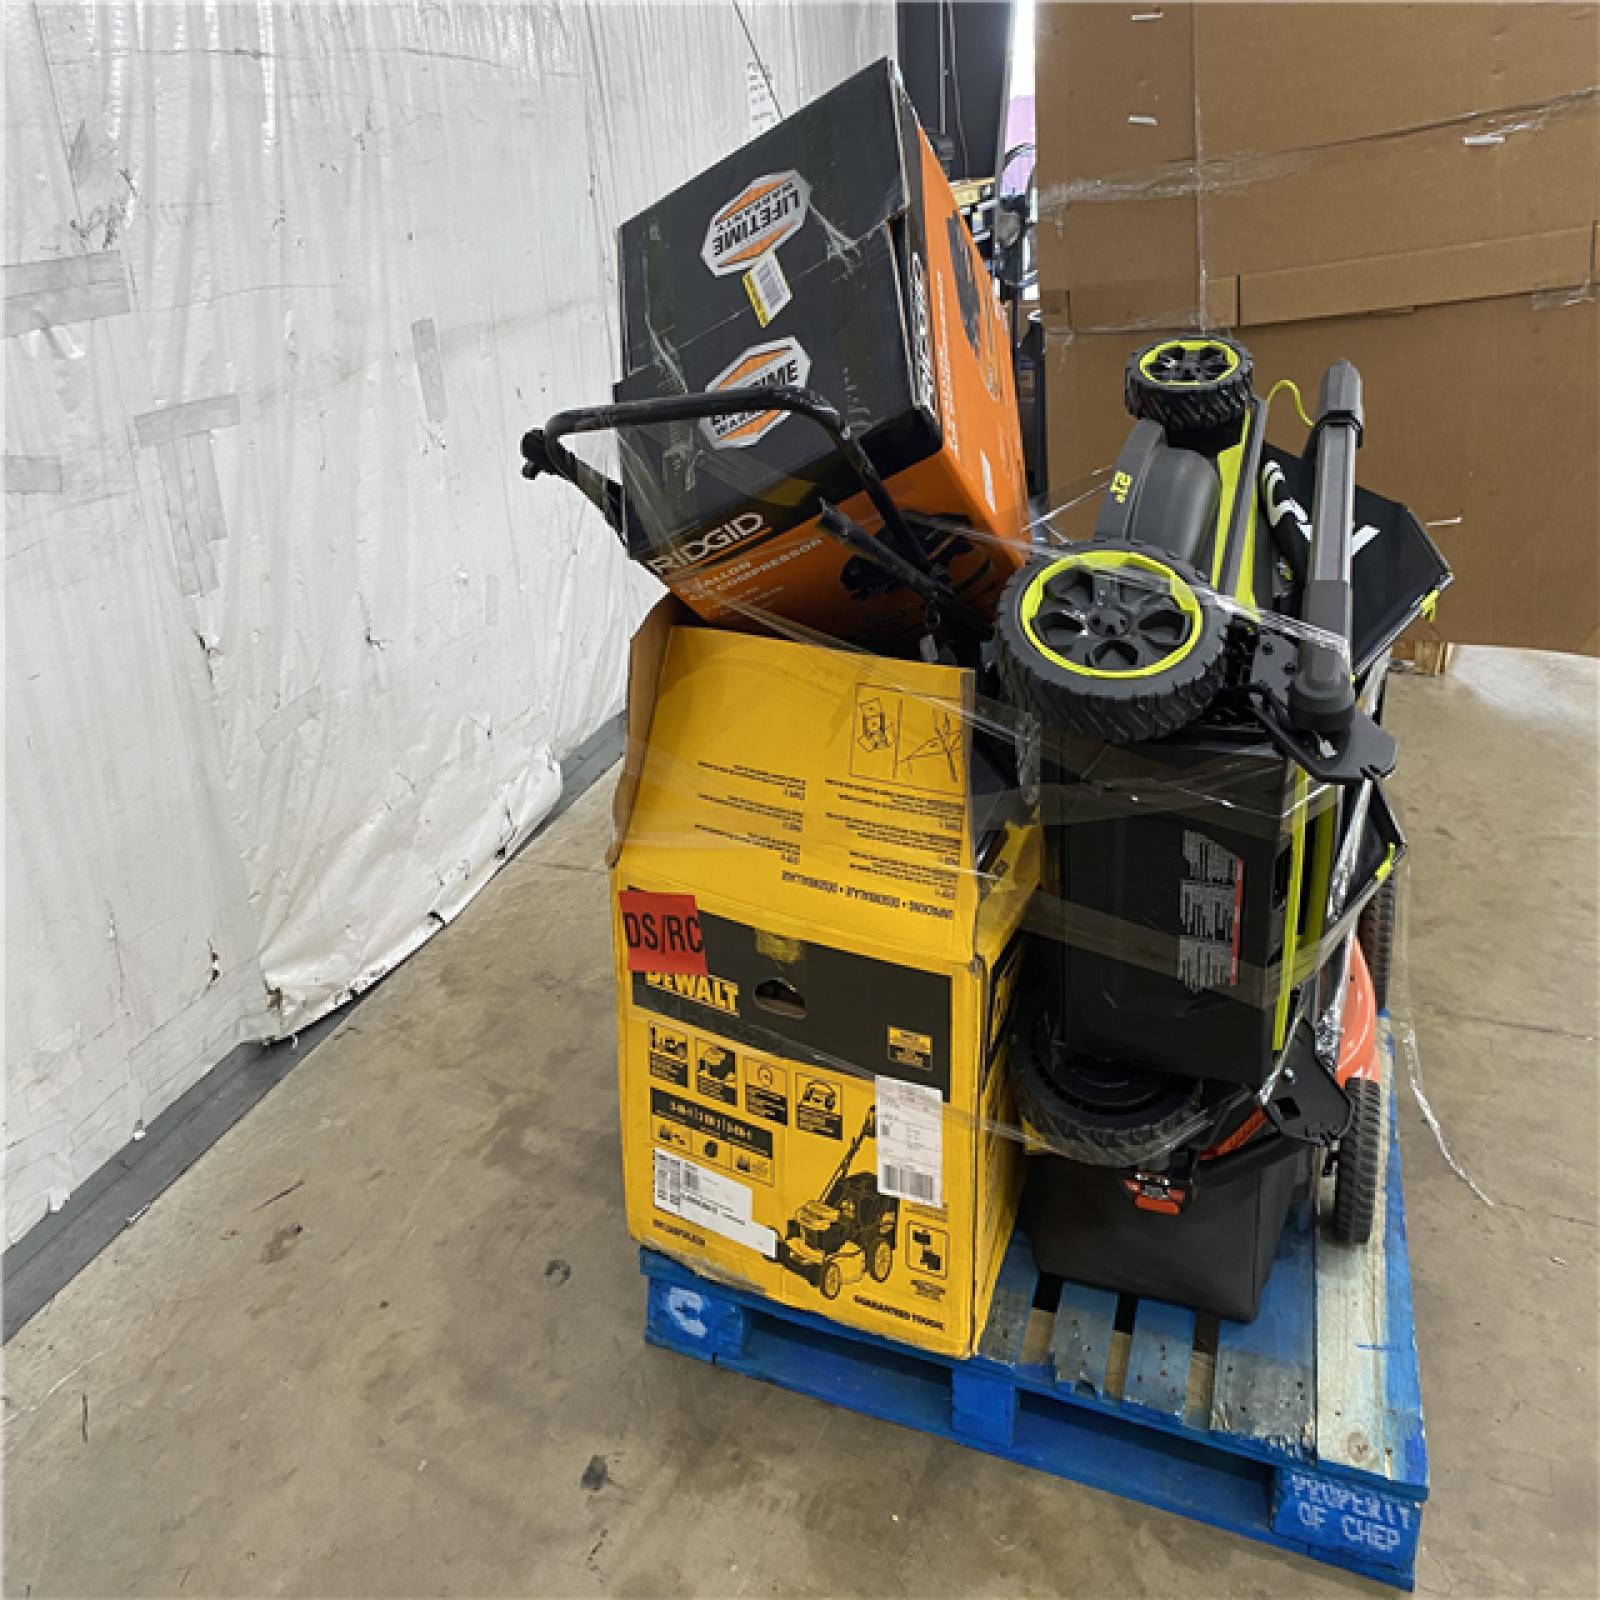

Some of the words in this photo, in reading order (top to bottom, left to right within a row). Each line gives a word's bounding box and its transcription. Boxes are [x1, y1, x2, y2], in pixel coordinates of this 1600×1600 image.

[712, 189, 799, 256] LIFETIME
[648, 512, 764, 575] RIDGID
[623, 912, 704, 954] DS/RC
[1341, 1514, 1401, 1551] CHEP
